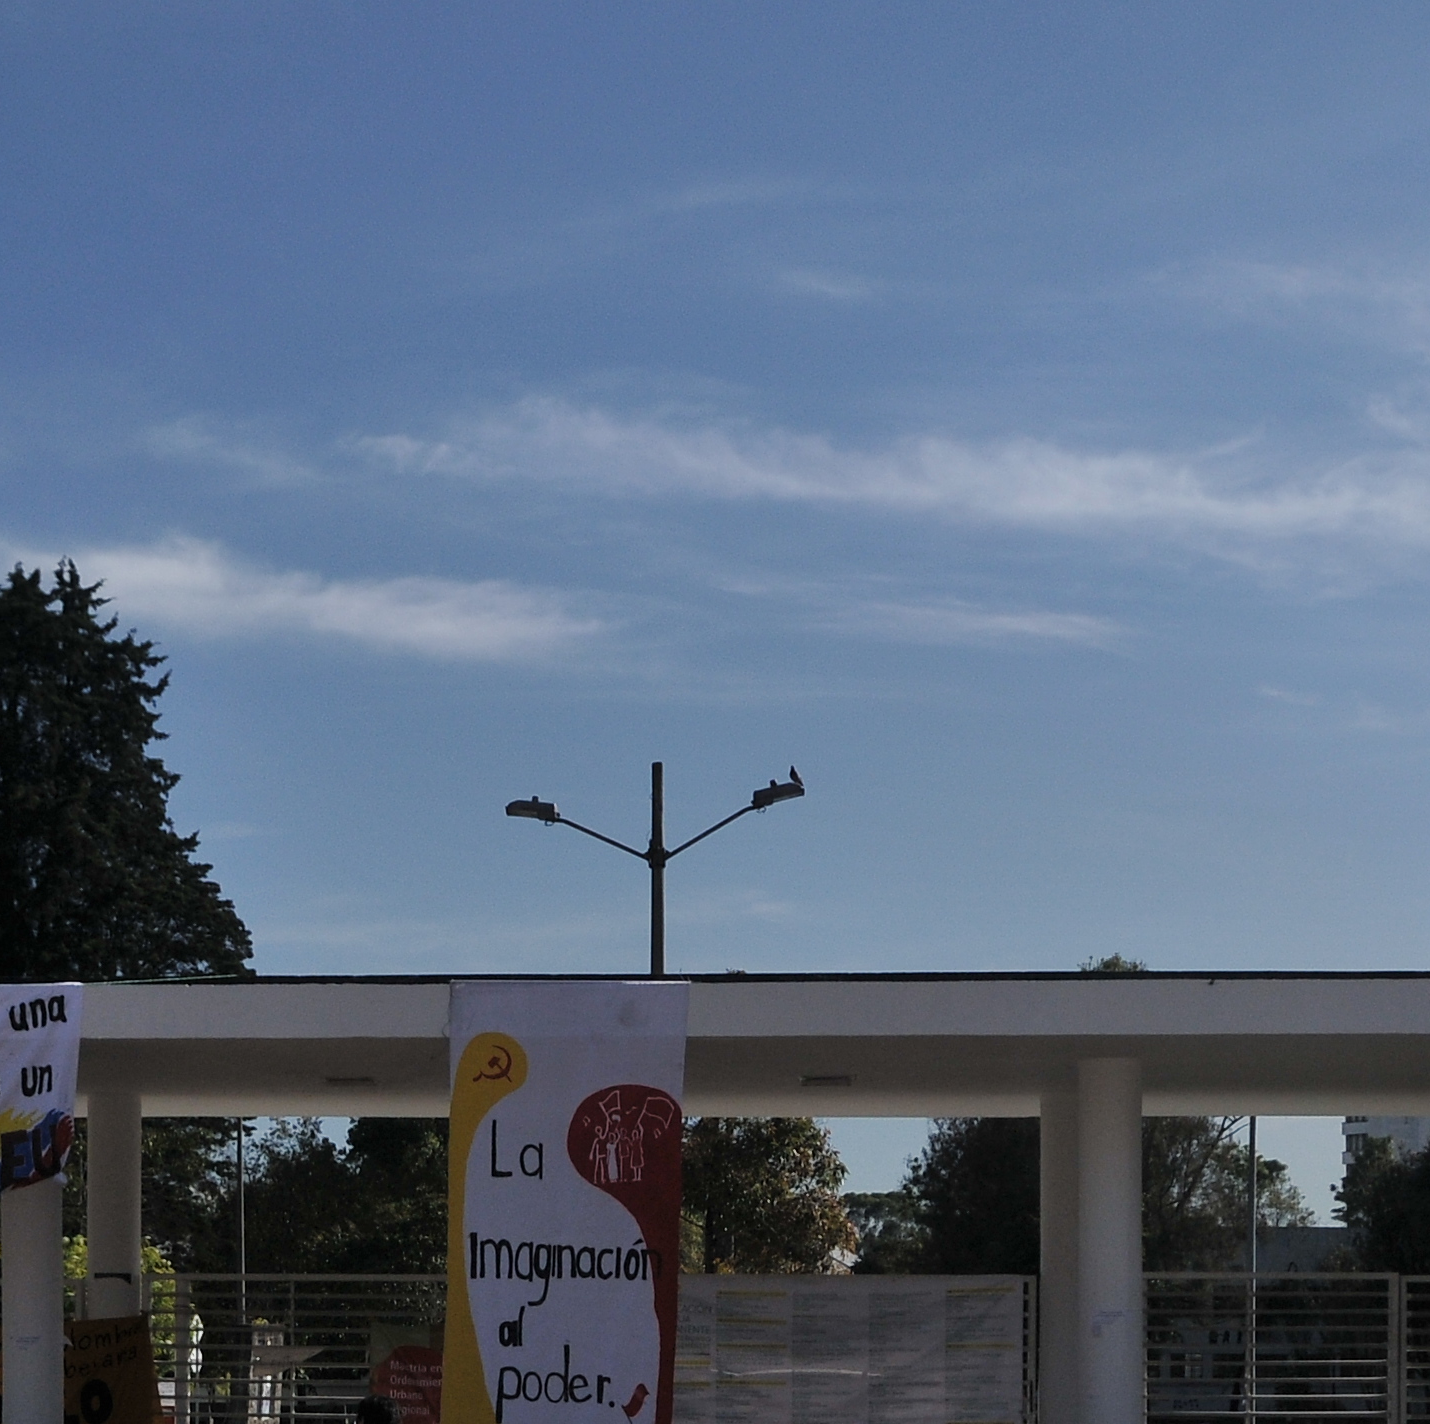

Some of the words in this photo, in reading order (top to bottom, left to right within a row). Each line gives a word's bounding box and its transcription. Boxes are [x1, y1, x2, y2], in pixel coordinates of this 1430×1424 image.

[9, 993, 68, 1032] una
[19, 1063, 54, 1096] un
[490, 1119, 544, 1180] La
[468, 1232, 663, 1307] Imaginación
[498, 1305, 526, 1349] al
[496, 1344, 617, 1424] poder.
